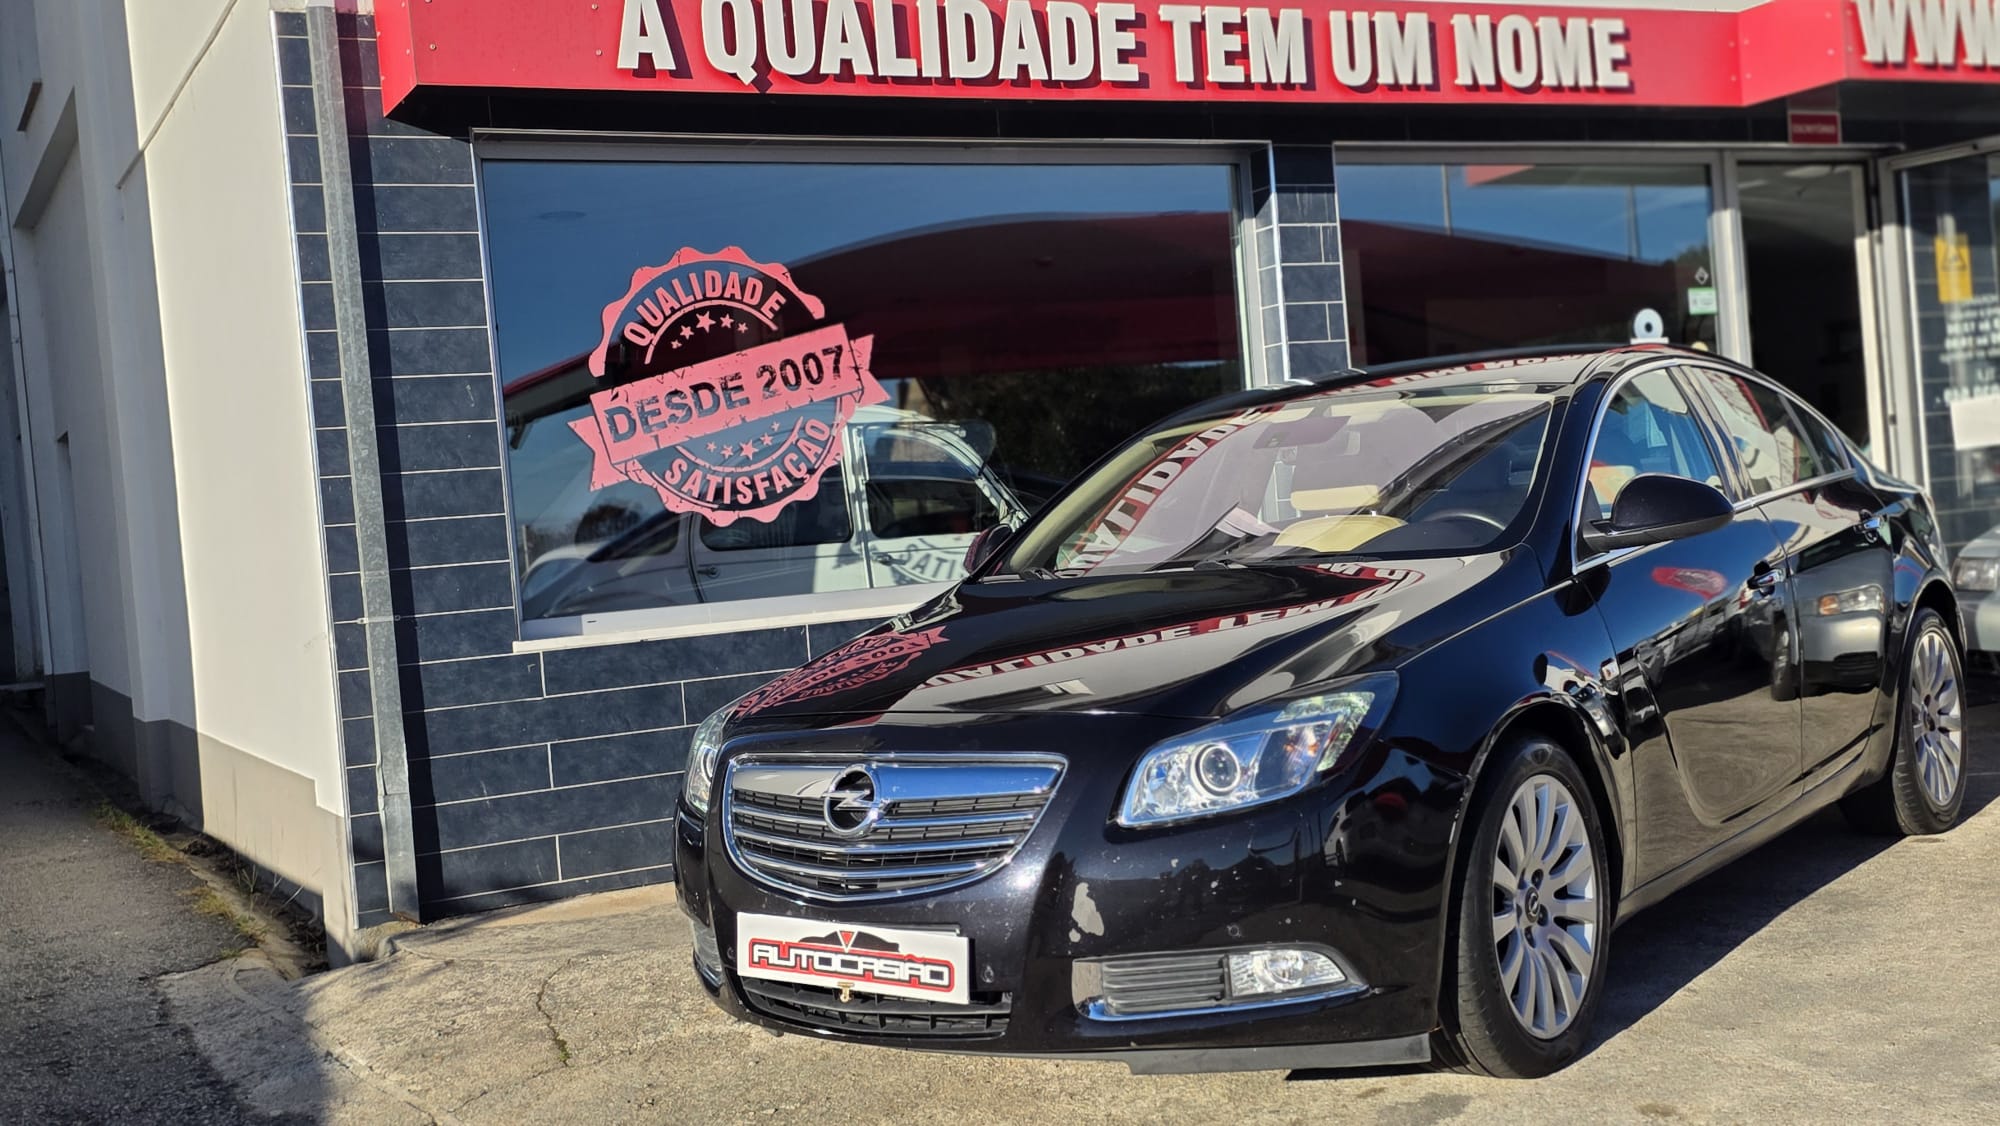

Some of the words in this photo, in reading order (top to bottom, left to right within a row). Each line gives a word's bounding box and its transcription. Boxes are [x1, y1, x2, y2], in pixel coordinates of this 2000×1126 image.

[616, 0, 676, 71] A
[701, 0, 1140, 86] QUALIDADE
[1158, 4, 1308, 84] TEM
[1329, 11, 1433, 87] UM
[1450, 14, 1630, 88] NOME
[623, 270, 787, 347] QUALIDADE
[603, 372, 750, 443] DESDE
[756, 345, 845, 399] 2007
[664, 416, 832, 505] SATISFAÇÃO
